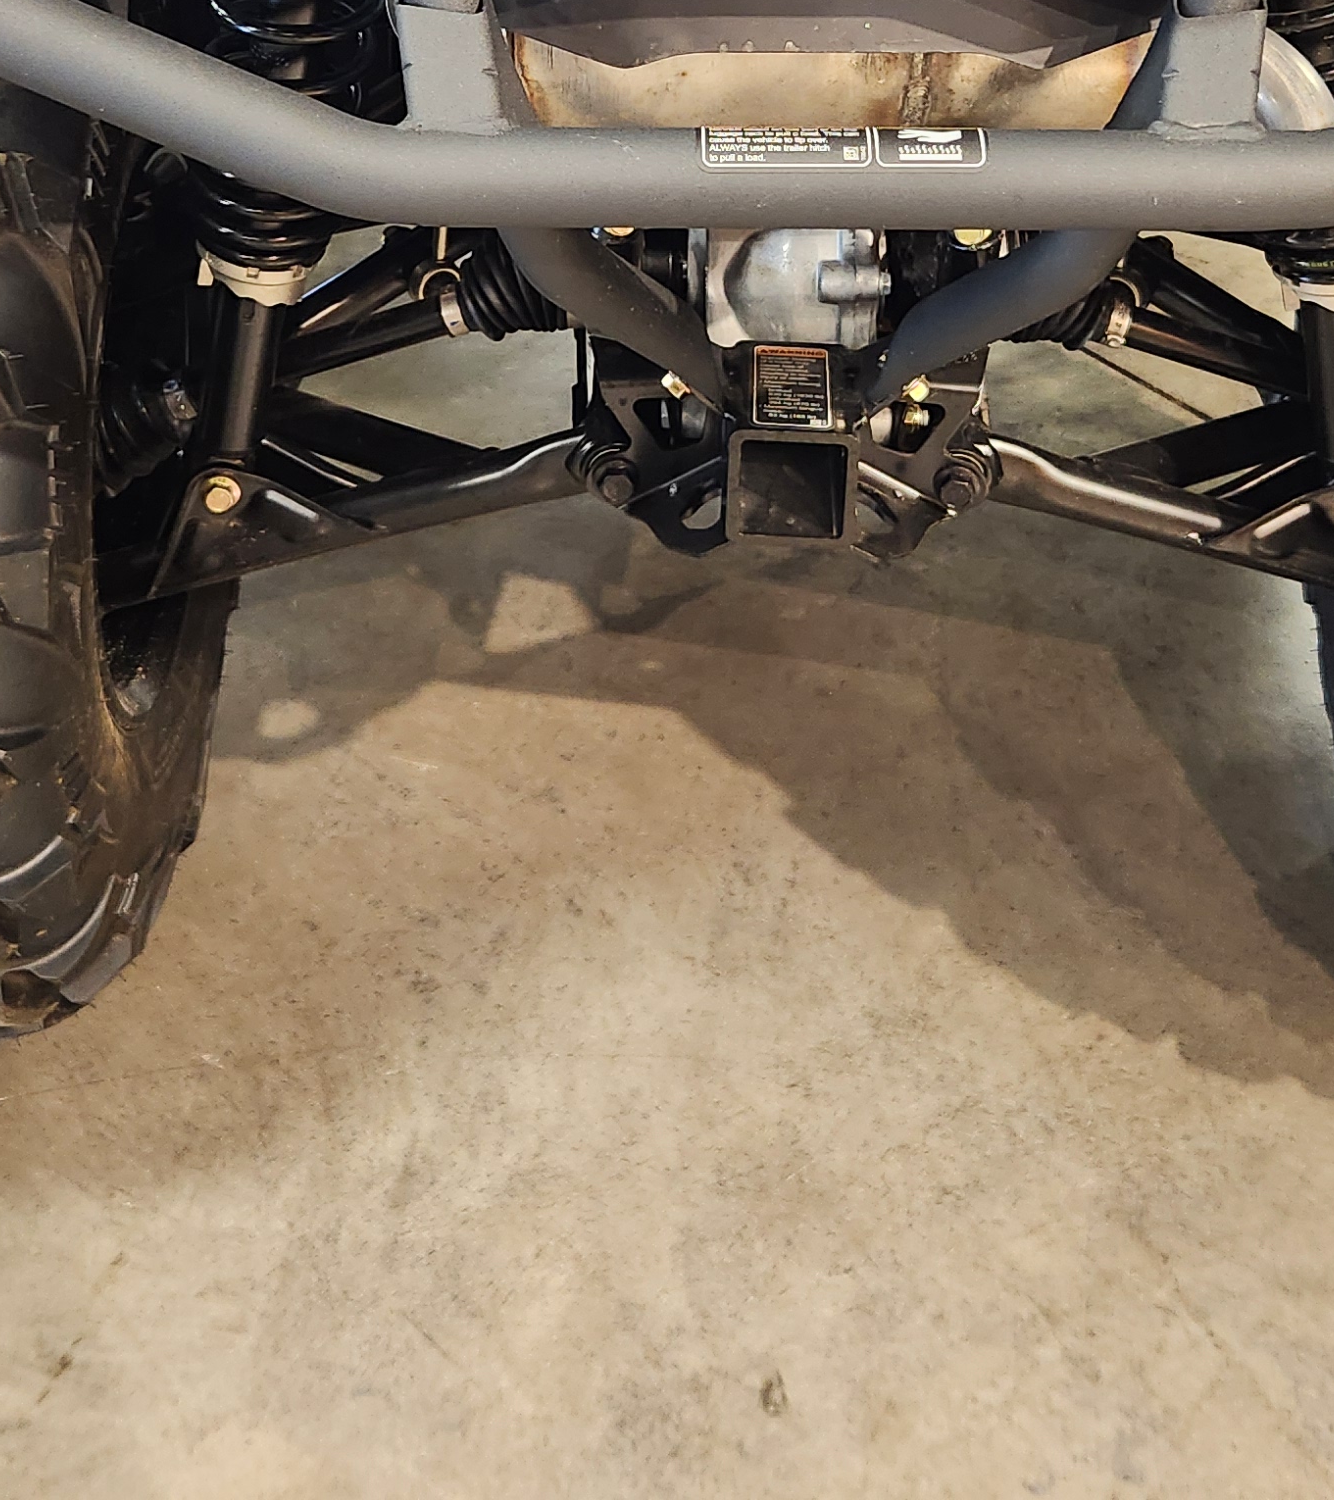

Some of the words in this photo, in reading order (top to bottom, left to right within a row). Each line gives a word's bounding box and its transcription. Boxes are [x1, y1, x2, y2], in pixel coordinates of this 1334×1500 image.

[709, 144, 748, 152] ALWAYS
[749, 144, 766, 152] use
[767, 144, 782, 152] the
[783, 144, 809, 152] trailer
[809, 144, 831, 152] hitch
[709, 153, 718, 161] to
[719, 153, 736, 162] pull
[736, 153, 744, 161] a
[744, 153, 767, 161] load.
